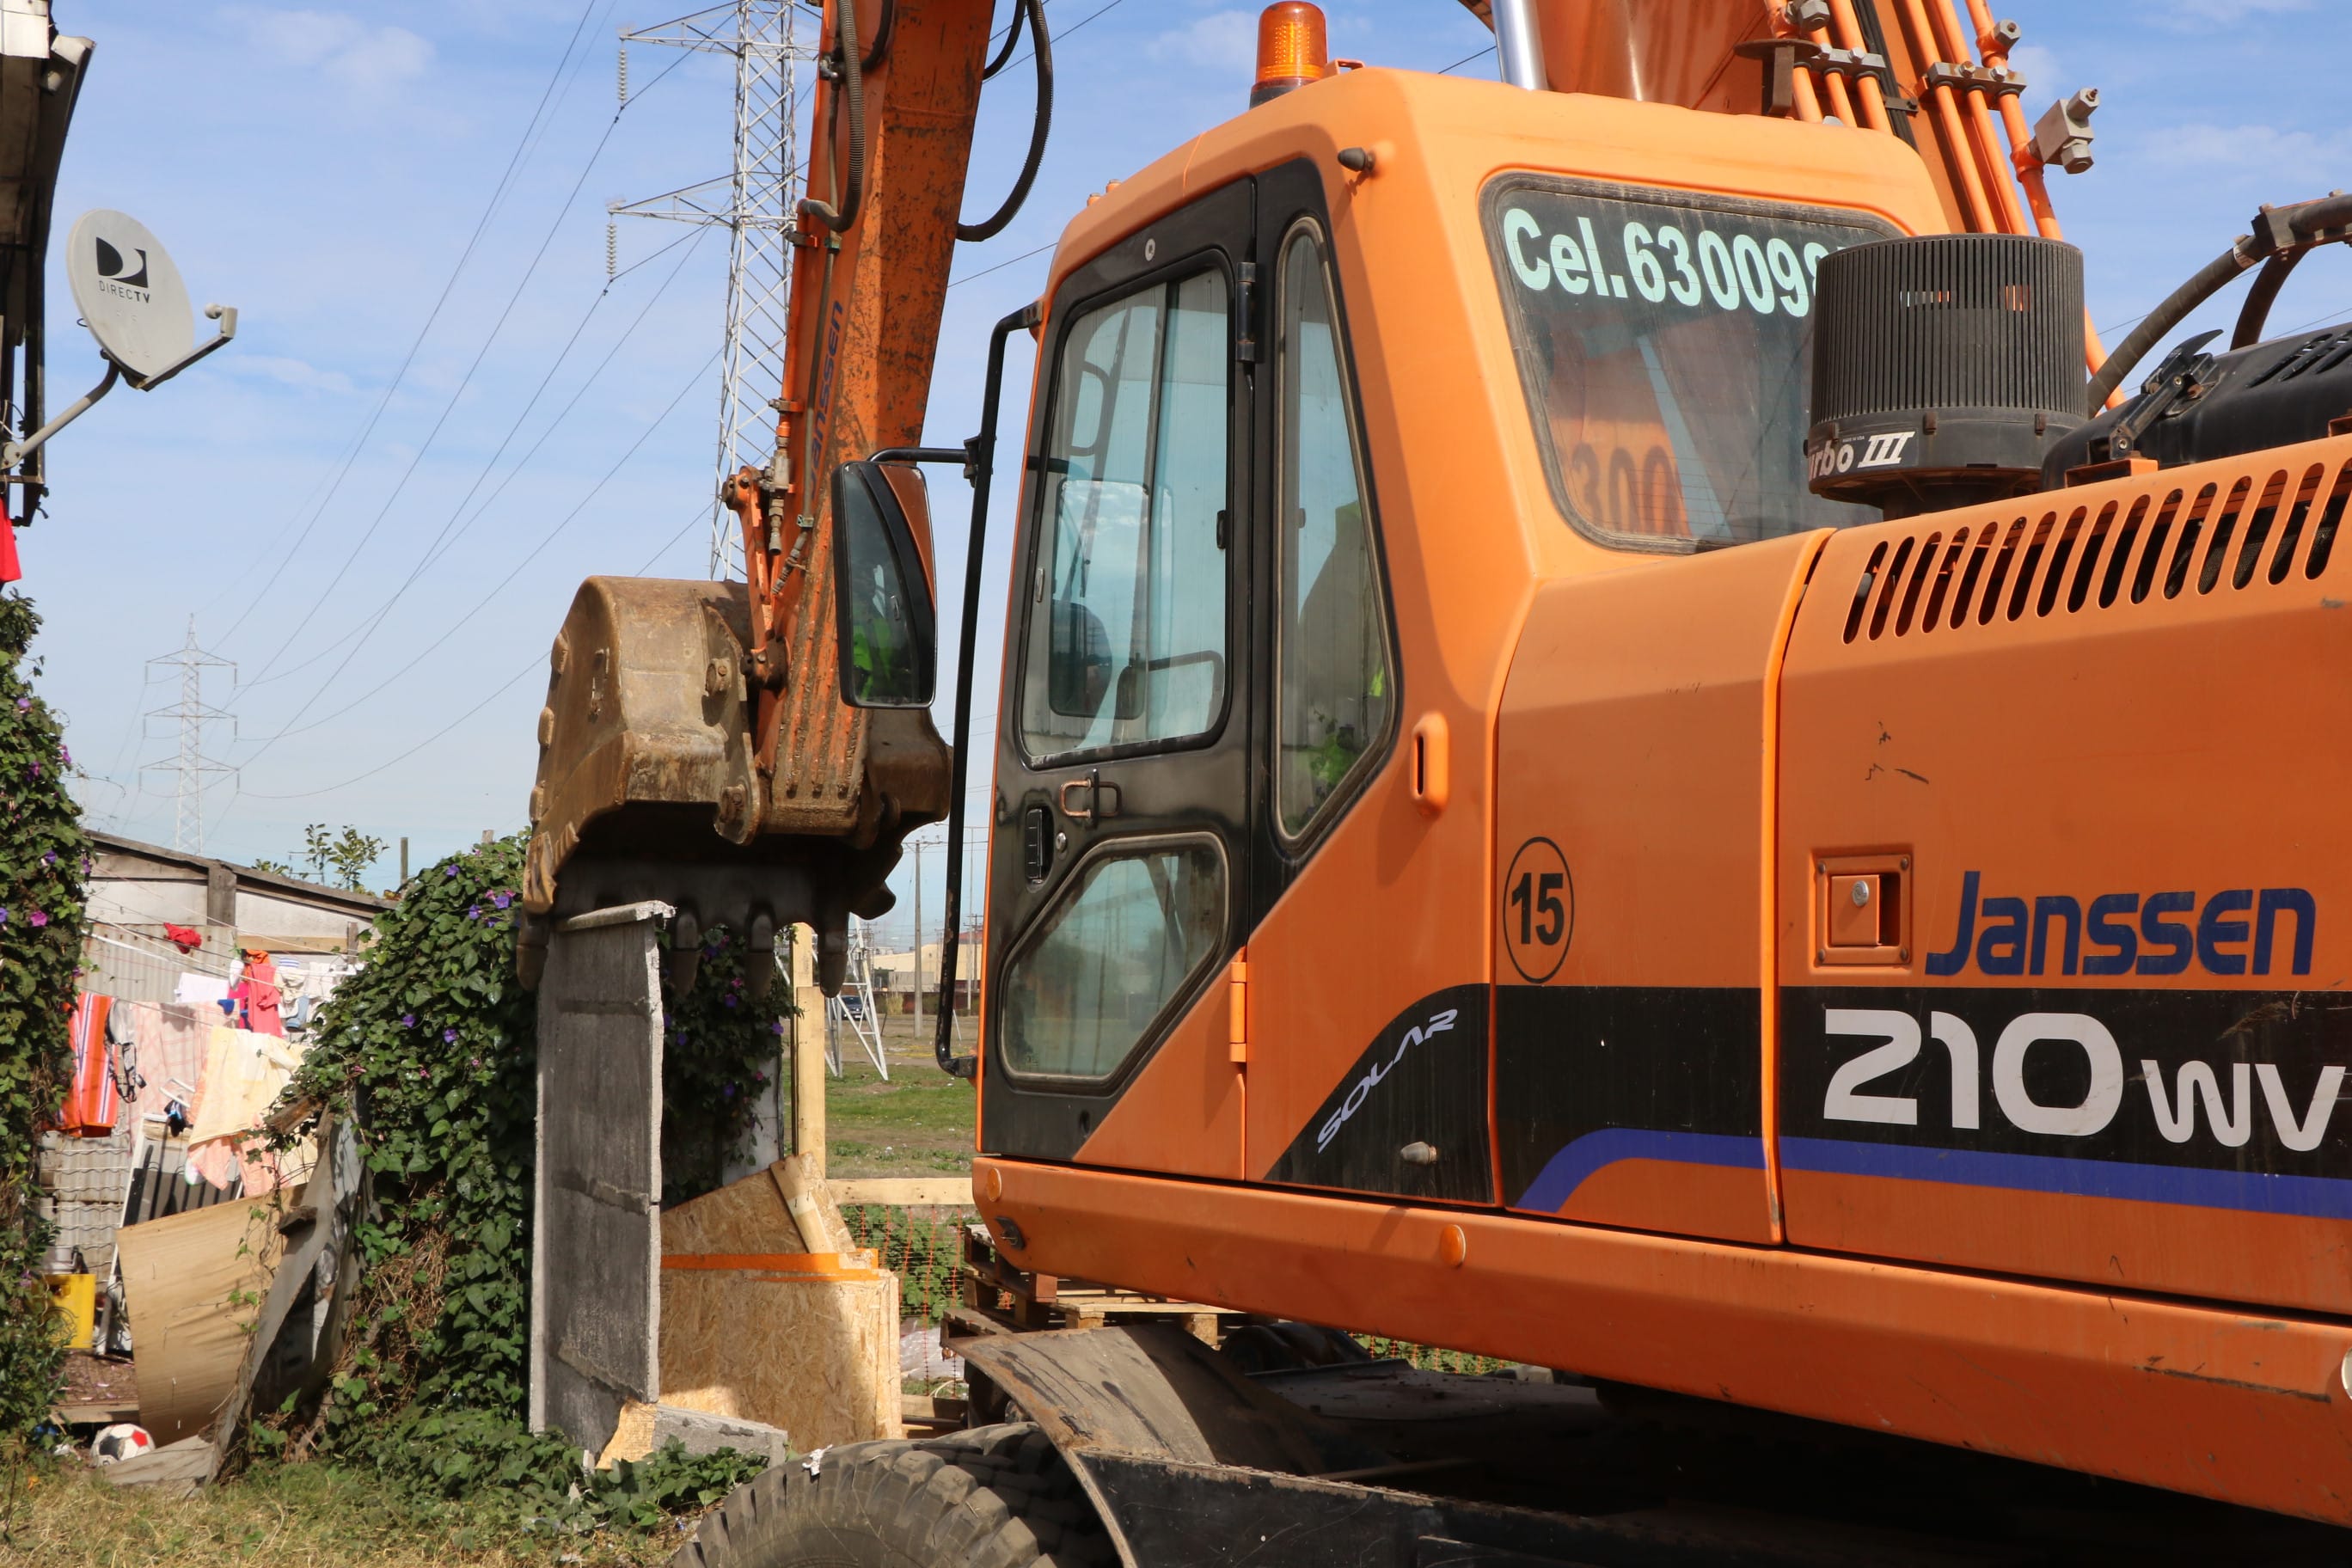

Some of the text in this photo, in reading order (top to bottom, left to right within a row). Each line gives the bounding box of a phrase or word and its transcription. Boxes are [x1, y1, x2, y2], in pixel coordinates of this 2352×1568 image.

[99, 280, 150, 303] DIRECTV
[1504, 208, 1846, 318] Cel.63009
[1809, 431, 1916, 481] urbo III
[1511, 872, 1565, 946] 15
[1926, 871, 2316, 977] Janssen
[1318, 1008, 1458, 1155] SOLAR
[1823, 1008, 2124, 1136] 210
